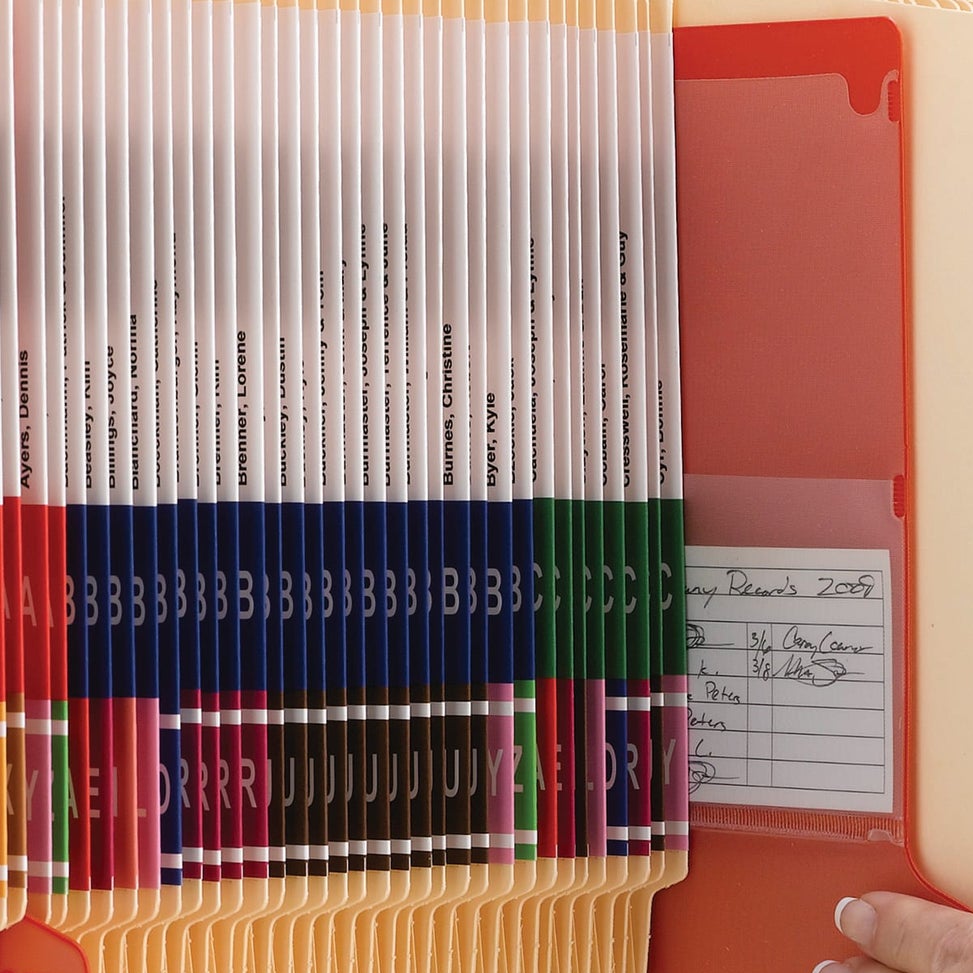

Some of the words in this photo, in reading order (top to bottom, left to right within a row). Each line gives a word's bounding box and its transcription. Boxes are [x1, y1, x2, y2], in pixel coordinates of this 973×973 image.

[19, 350, 29, 419] Dennis
[237, 330, 246, 397] Lorene
[442, 324, 453, 409] Christine
[487, 392, 497, 433] Kyle
[20, 425, 32, 489] Ayers,
[237, 404, 249, 487] Brenner,
[443, 414, 454, 486] Burnes,
[487, 439, 498, 487] Byer,
[22, 575, 37, 627] A
[109, 575, 123, 627] B
[133, 575, 146, 627] B
[239, 570, 255, 620] B
[443, 566, 460, 616] B
[487, 567, 502, 616] B
[726, 569, 798, 597] Records
[752, 657, 772, 682] 3/8
[241, 757, 257, 809] R
[444, 748, 460, 798] U
[488, 748, 504, 797] Y
